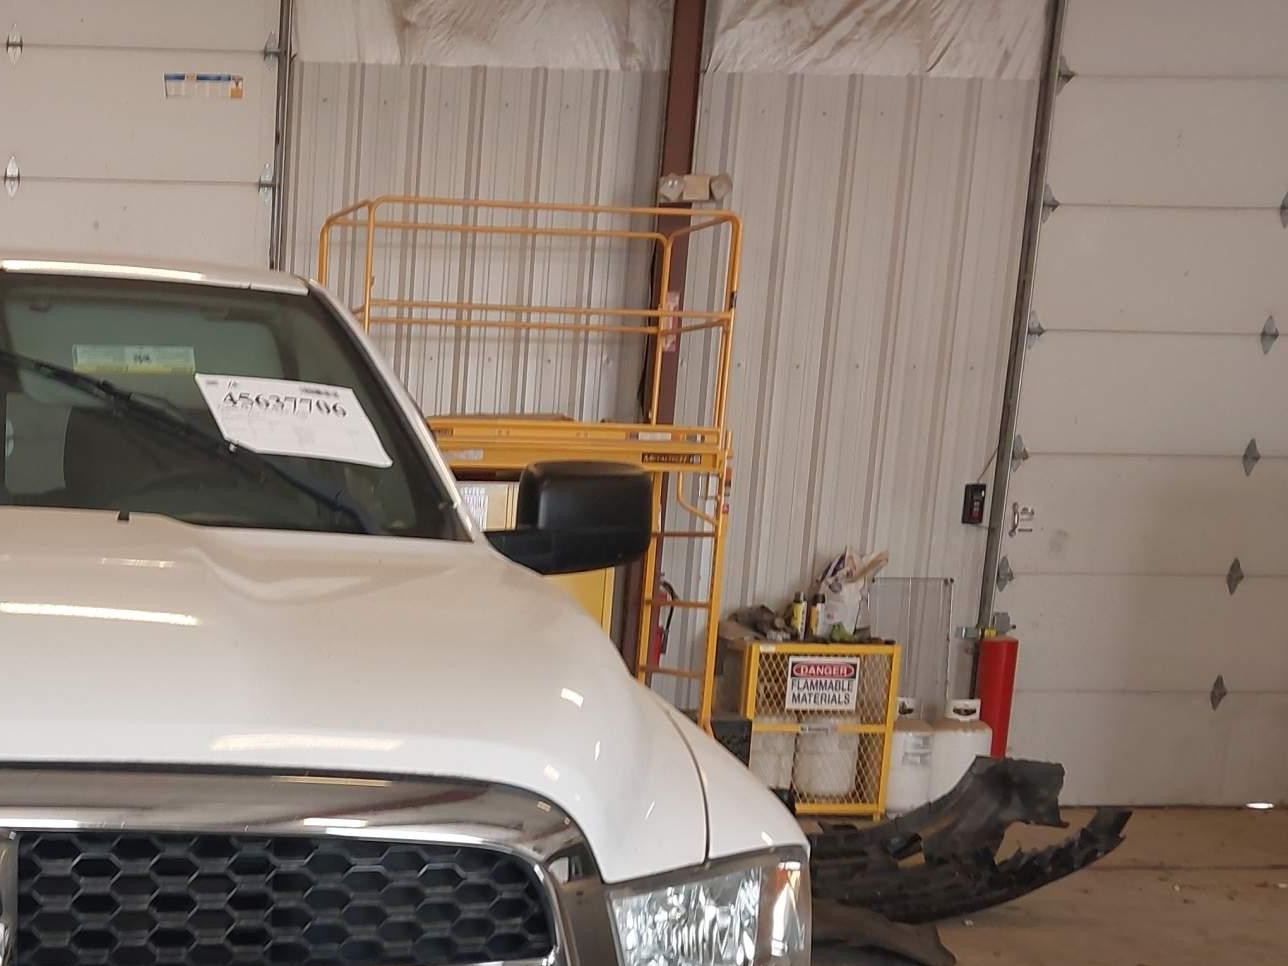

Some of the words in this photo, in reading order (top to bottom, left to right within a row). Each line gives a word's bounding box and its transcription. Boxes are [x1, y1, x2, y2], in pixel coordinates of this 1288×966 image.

[800, 664, 848, 676] DANGER
[792, 679, 853, 692] FLAMMABLE
[792, 692, 851, 705] MATERIALS
